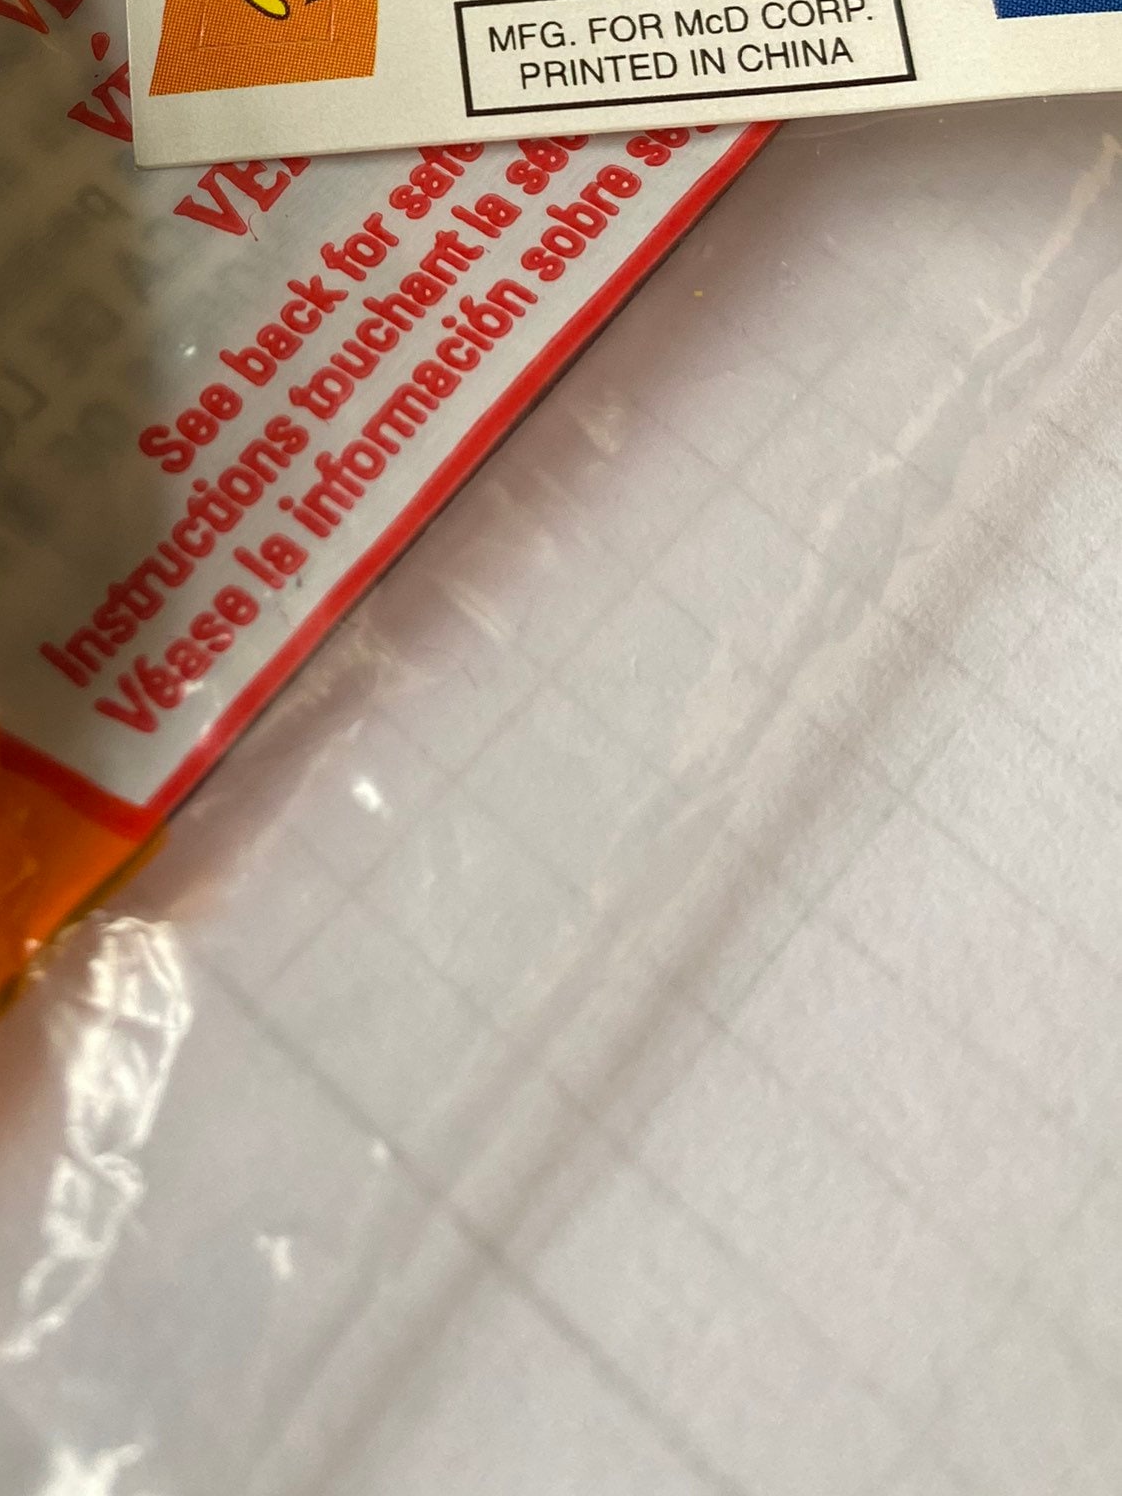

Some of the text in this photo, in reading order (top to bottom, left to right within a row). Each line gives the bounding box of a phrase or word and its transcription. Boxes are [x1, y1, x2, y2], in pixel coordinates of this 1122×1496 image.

[488, 22, 576, 53] MFG.
[588, 13, 664, 45] FOR
[674, 6, 749, 37] McD
[520, 37, 854, 90] PRINTED IN CHINA
[39, 414, 310, 689] Instructions
[288, 229, 485, 420] touchant
[451, 193, 522, 239] la
[94, 584, 260, 734] Véase
[233, 532, 310, 590] la
[277, 278, 538, 539] información
[521, 164, 642, 282] sobre
[138, 382, 244, 475] See
[219, 274, 350, 387] back
[320, 211, 400, 282] for
